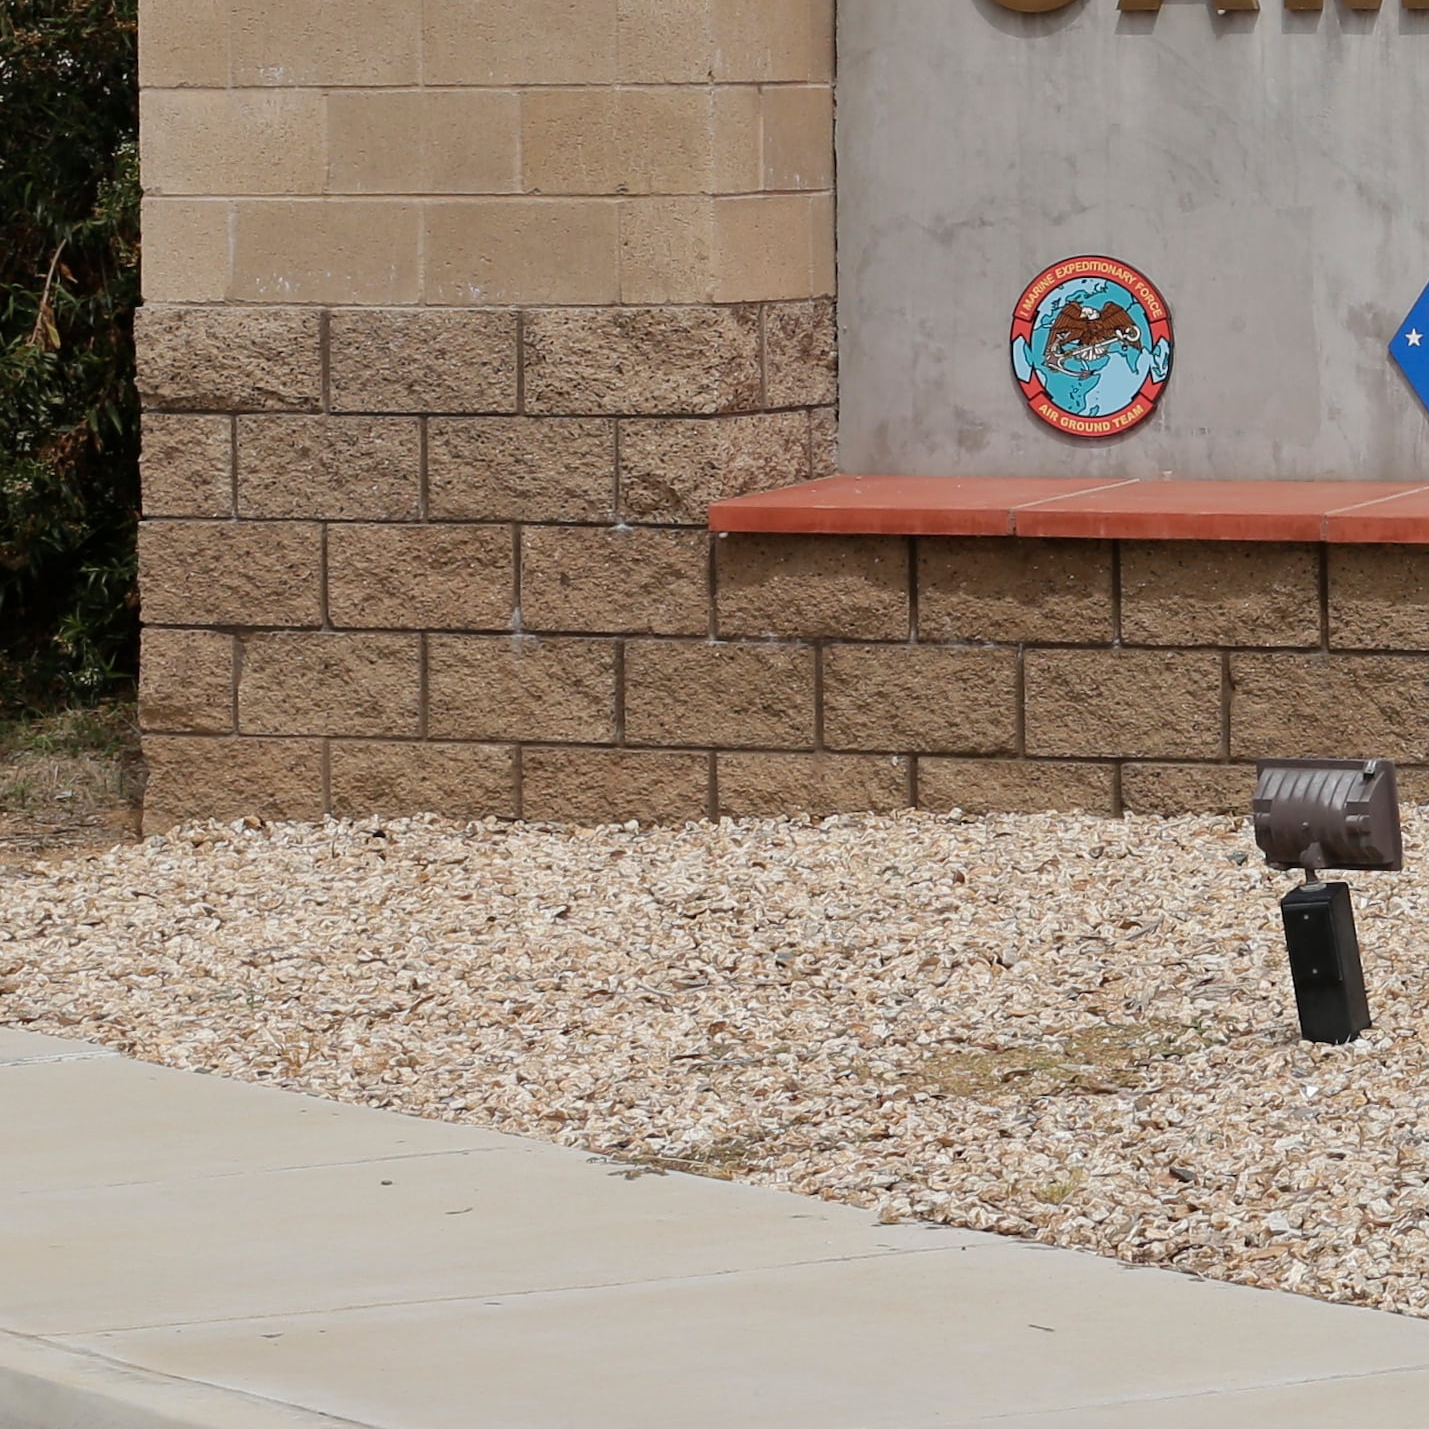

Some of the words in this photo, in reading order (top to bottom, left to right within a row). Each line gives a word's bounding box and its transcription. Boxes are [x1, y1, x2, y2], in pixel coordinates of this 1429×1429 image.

[1024, 275, 1055, 309] MARINE
[1056, 262, 1136, 285] EXPEDITIONARY
[1136, 284, 1163, 318] FORCE
[1039, 404, 1058, 422] AIR
[1061, 417, 1110, 432] GROUND
[1113, 405, 1144, 428] TEAM
